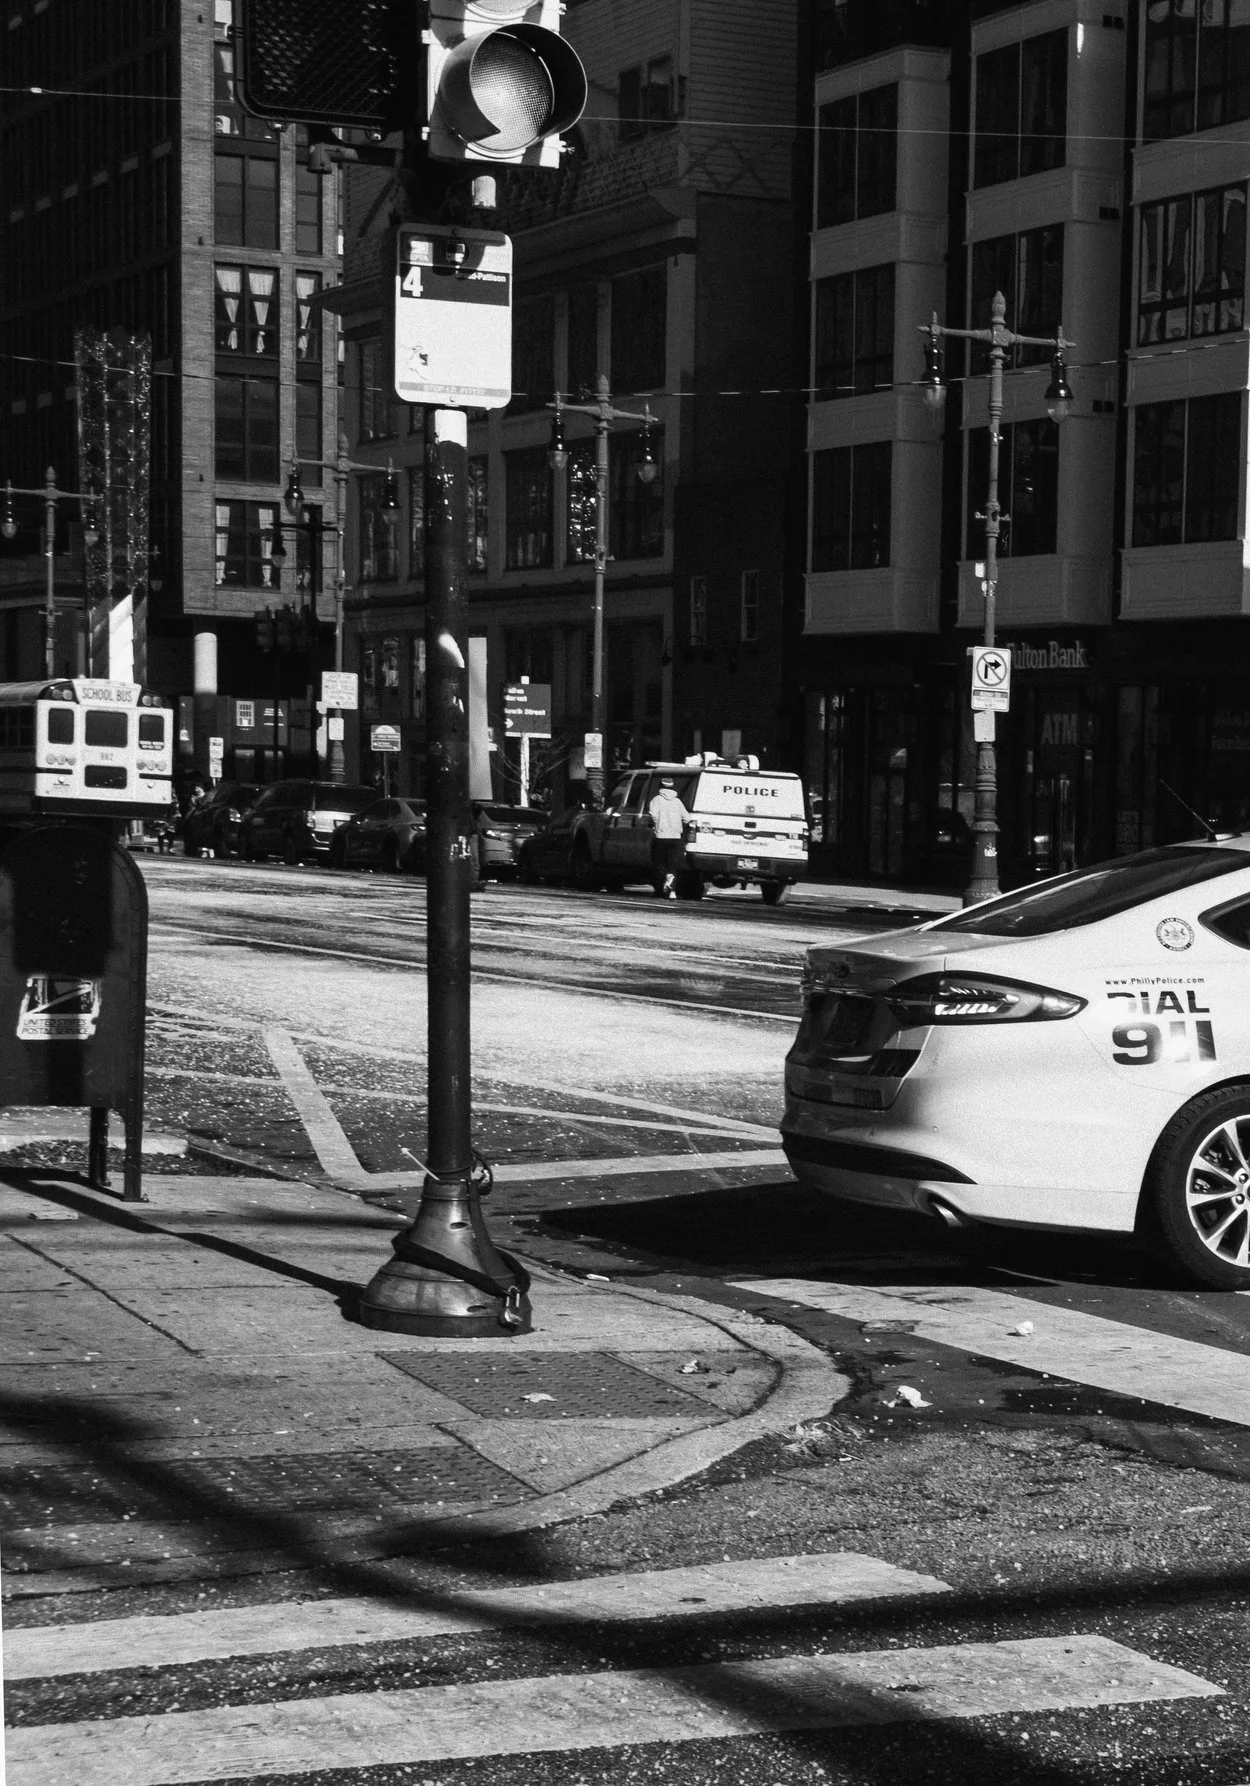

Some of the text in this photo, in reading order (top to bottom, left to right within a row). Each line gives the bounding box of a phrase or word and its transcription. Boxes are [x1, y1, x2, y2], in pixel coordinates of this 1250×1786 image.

[403, 266, 424, 298] 4
[1048, 641, 1090, 669] Bank
[82, 687, 133, 703] SCHOOL BUS
[1041, 713, 1078, 745] ATM
[723, 785, 779, 797] POLICE
[1105, 977, 1206, 986] www.PhillyPolice.com
